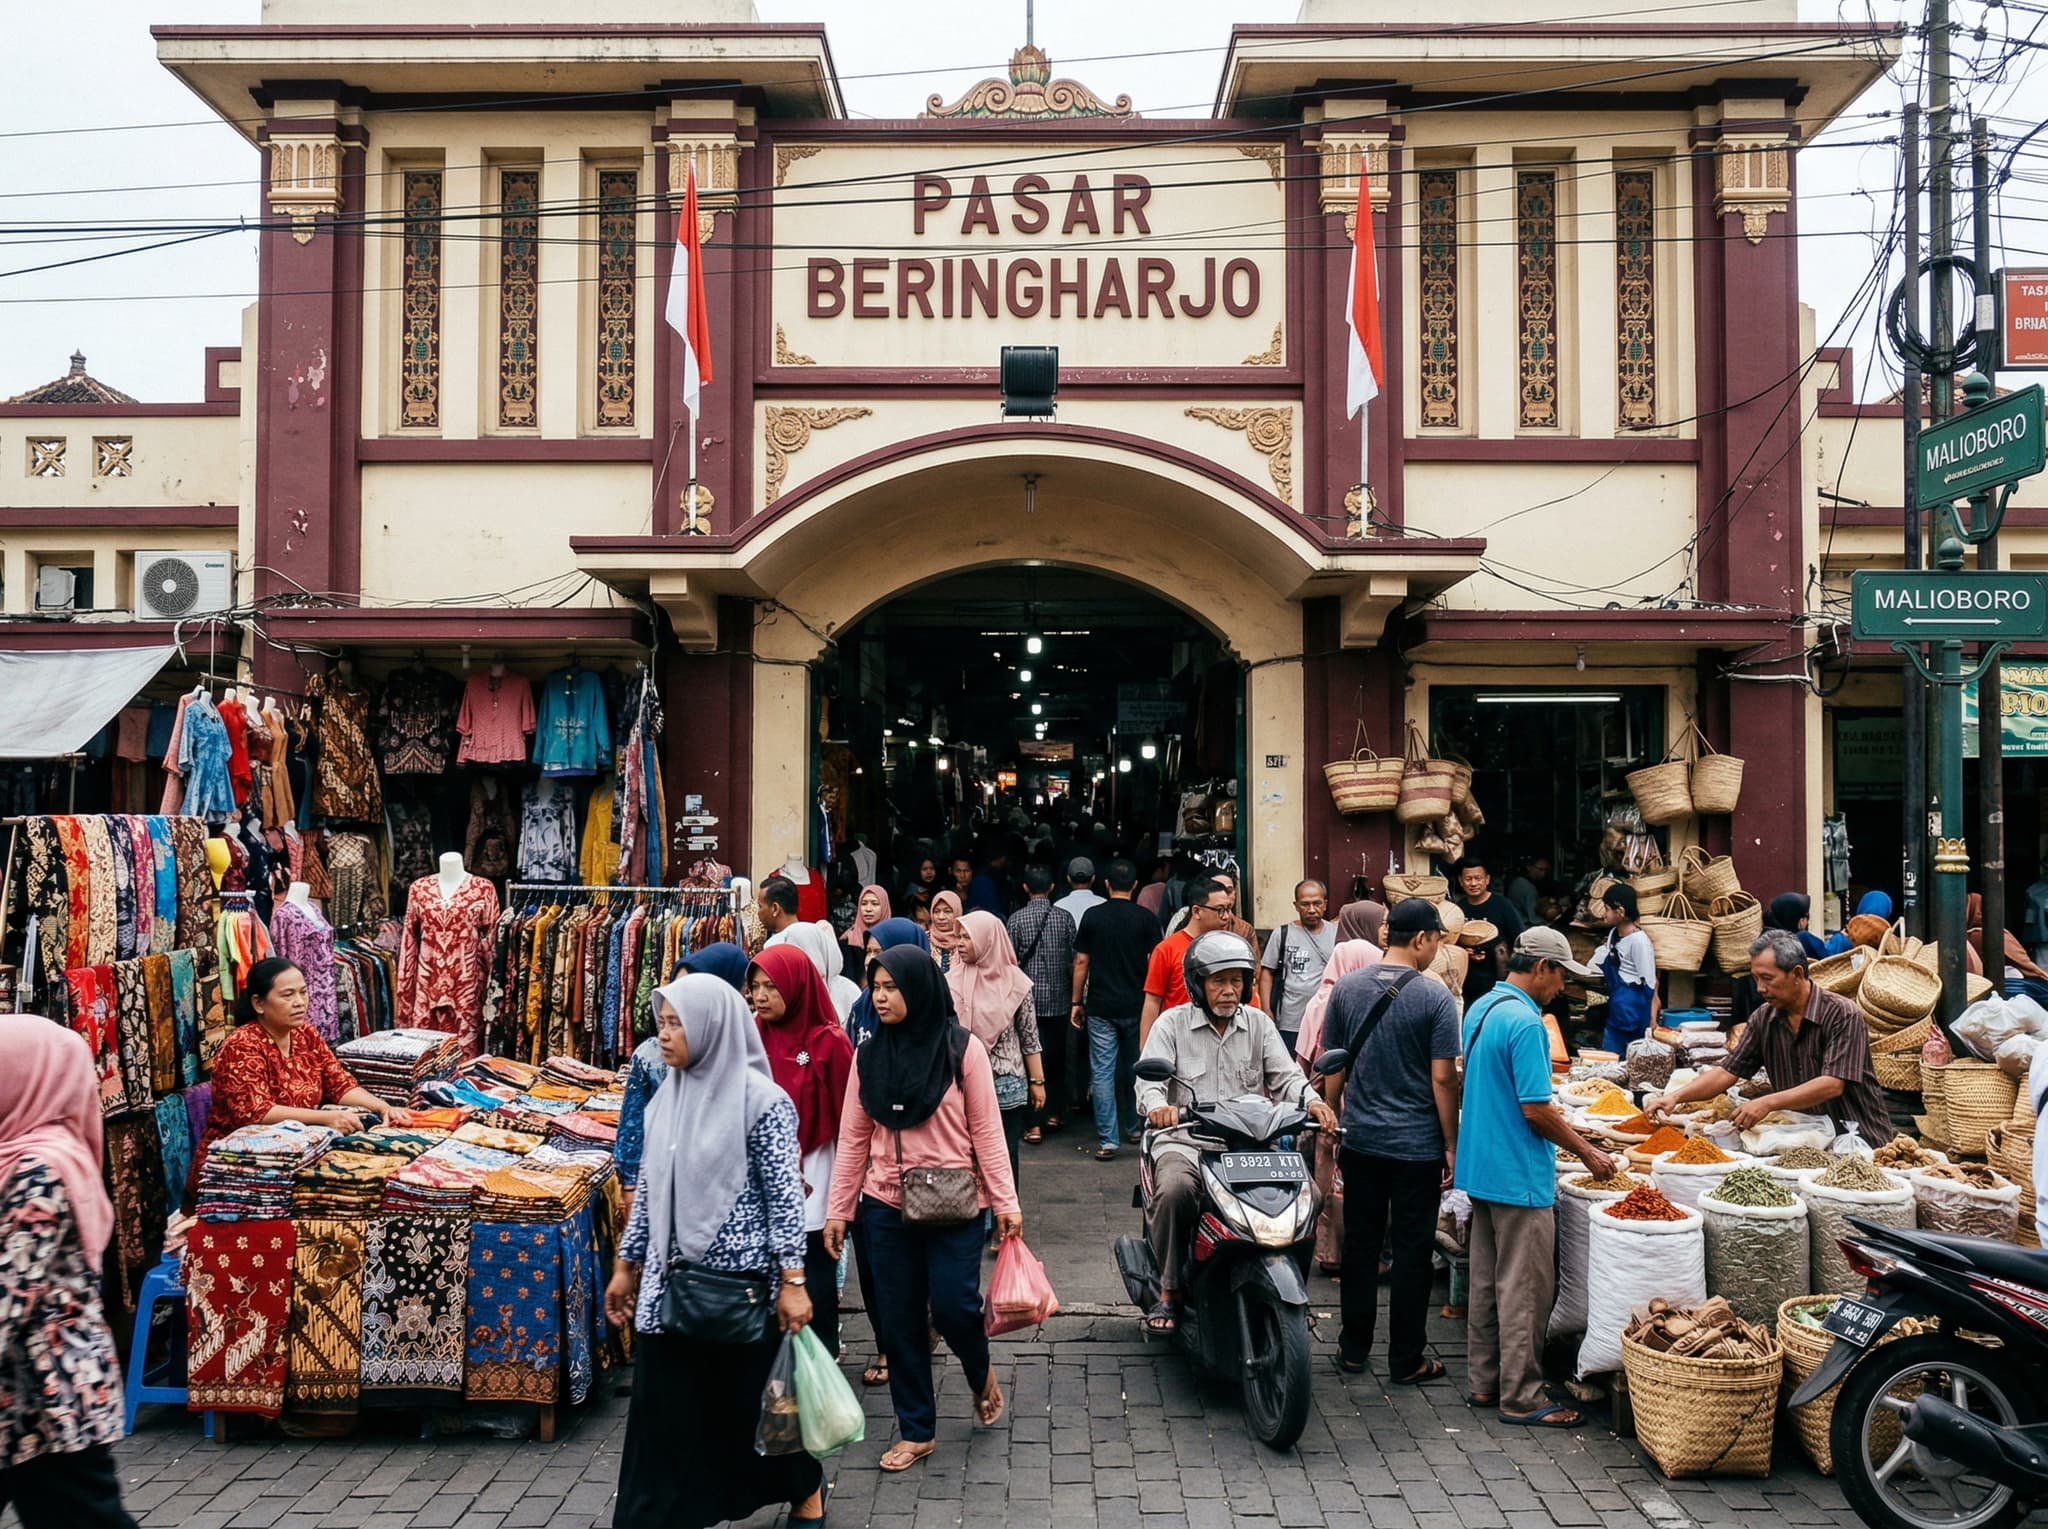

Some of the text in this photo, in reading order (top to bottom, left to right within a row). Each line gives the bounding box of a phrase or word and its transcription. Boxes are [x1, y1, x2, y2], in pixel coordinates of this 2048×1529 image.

[914, 174, 1152, 235] PASAR
[807, 257, 1261, 319] BERINGHARJO
[1926, 413, 2027, 472] MALIOBORO
[1875, 589, 2031, 611] MALIOBORO
[1225, 1157, 1234, 1168] B
